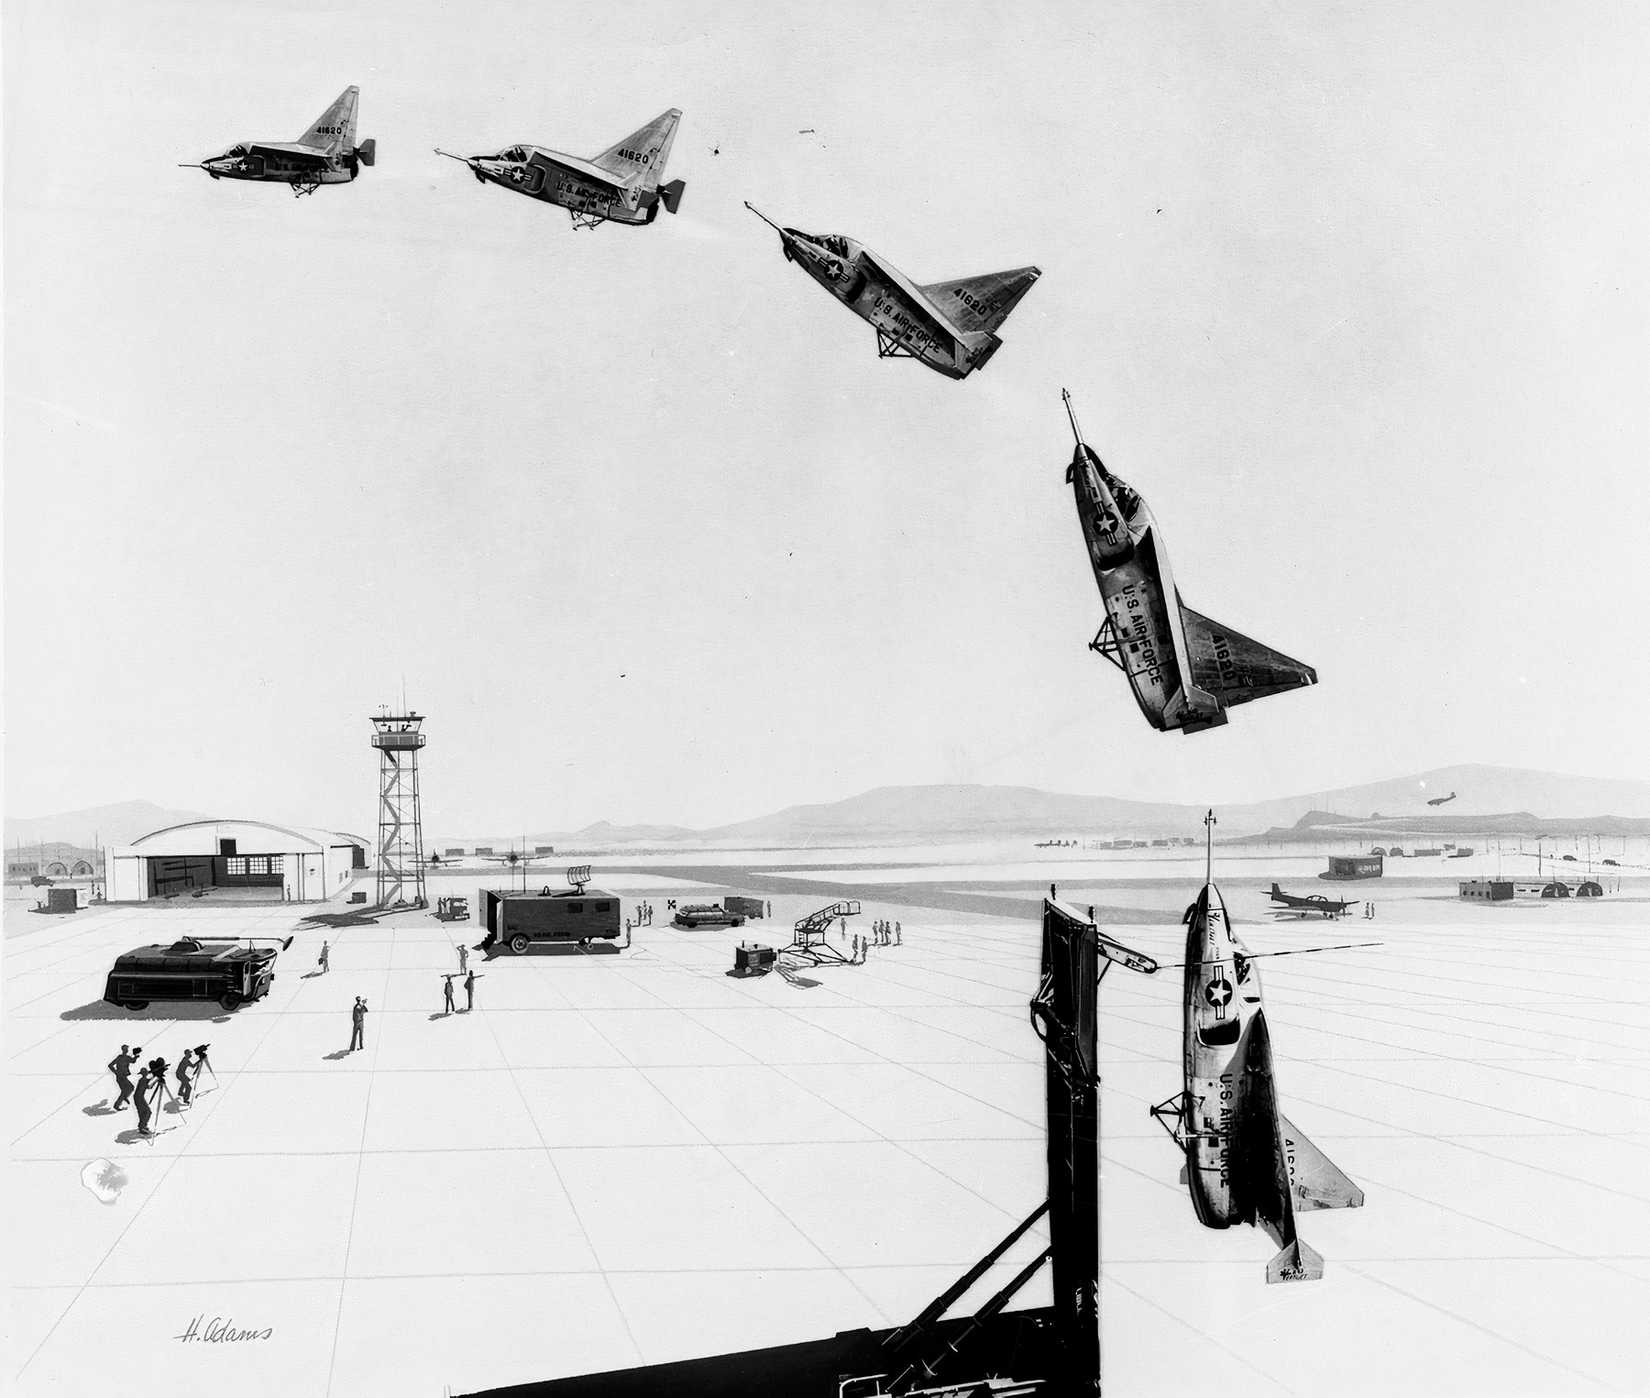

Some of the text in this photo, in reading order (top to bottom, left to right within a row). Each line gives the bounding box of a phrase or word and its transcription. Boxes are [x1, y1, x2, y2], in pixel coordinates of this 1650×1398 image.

[316, 126, 342, 134] 41620
[618, 148, 649, 164] 41620
[953, 288, 988, 316] 41620
[874, 296, 944, 353] U.S. AIR FORCE
[1122, 584, 1164, 686] U.S. AIR FORCE
[1212, 633, 1236, 681] 41620
[1220, 1073, 1233, 1105] U.S.
